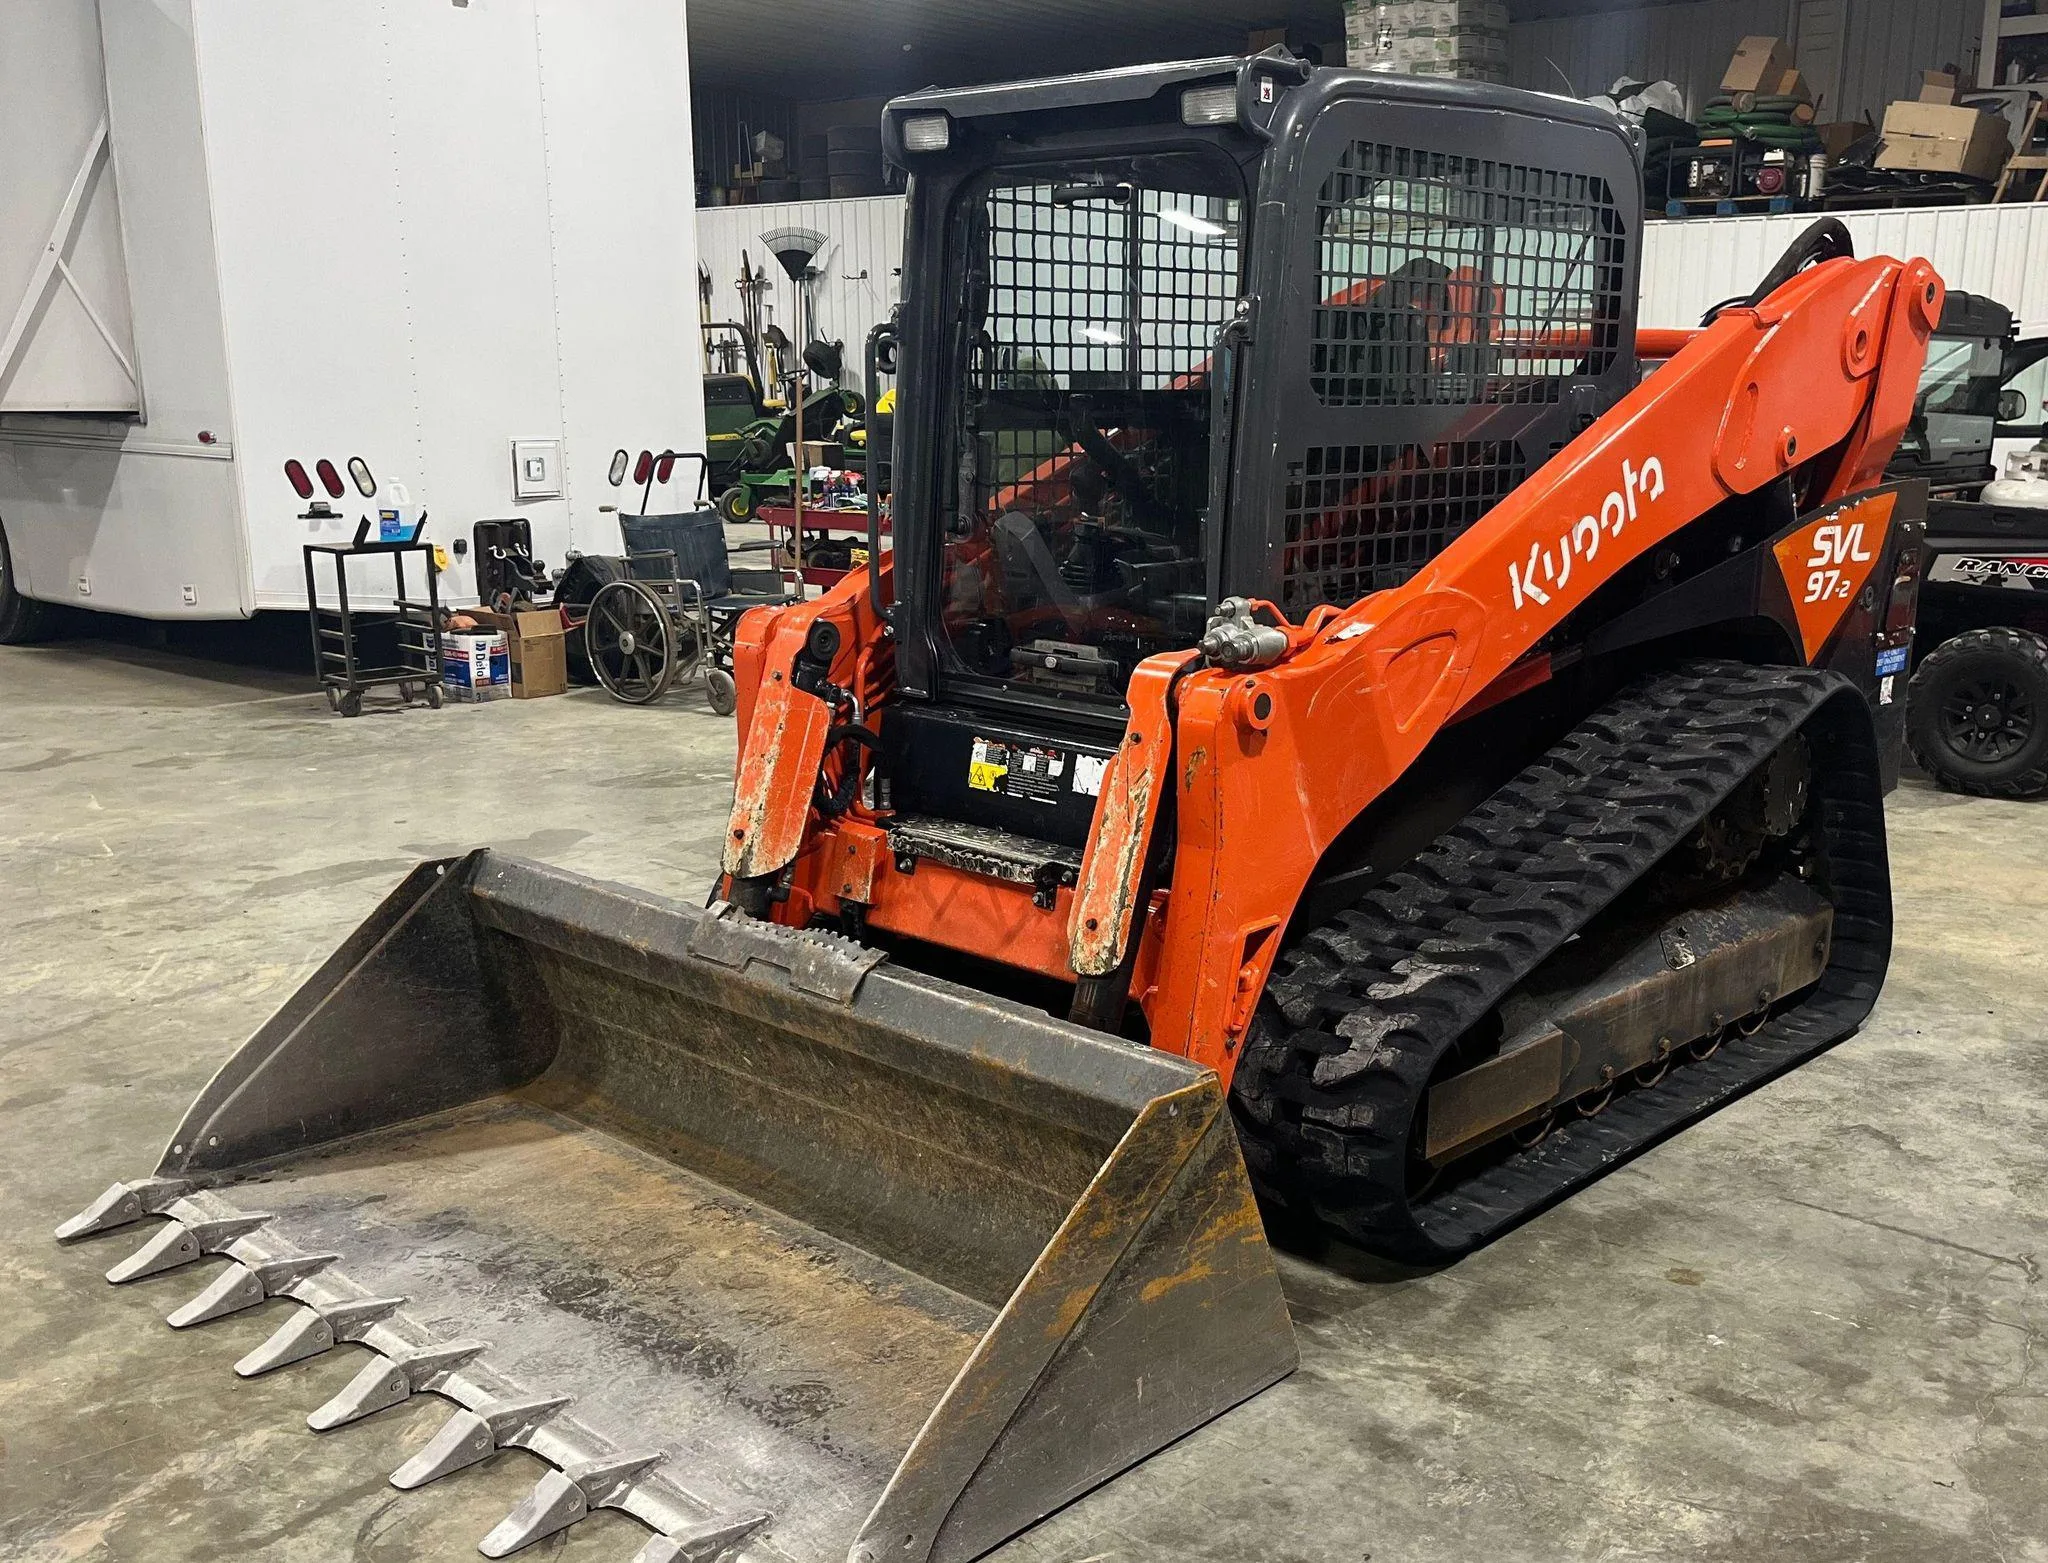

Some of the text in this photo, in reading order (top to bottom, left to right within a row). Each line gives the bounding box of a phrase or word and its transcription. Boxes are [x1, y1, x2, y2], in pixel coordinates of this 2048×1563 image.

[1508, 456, 1665, 611] Kubota
[1807, 523, 1871, 568] SVL
[475, 653, 486, 677] Delo
